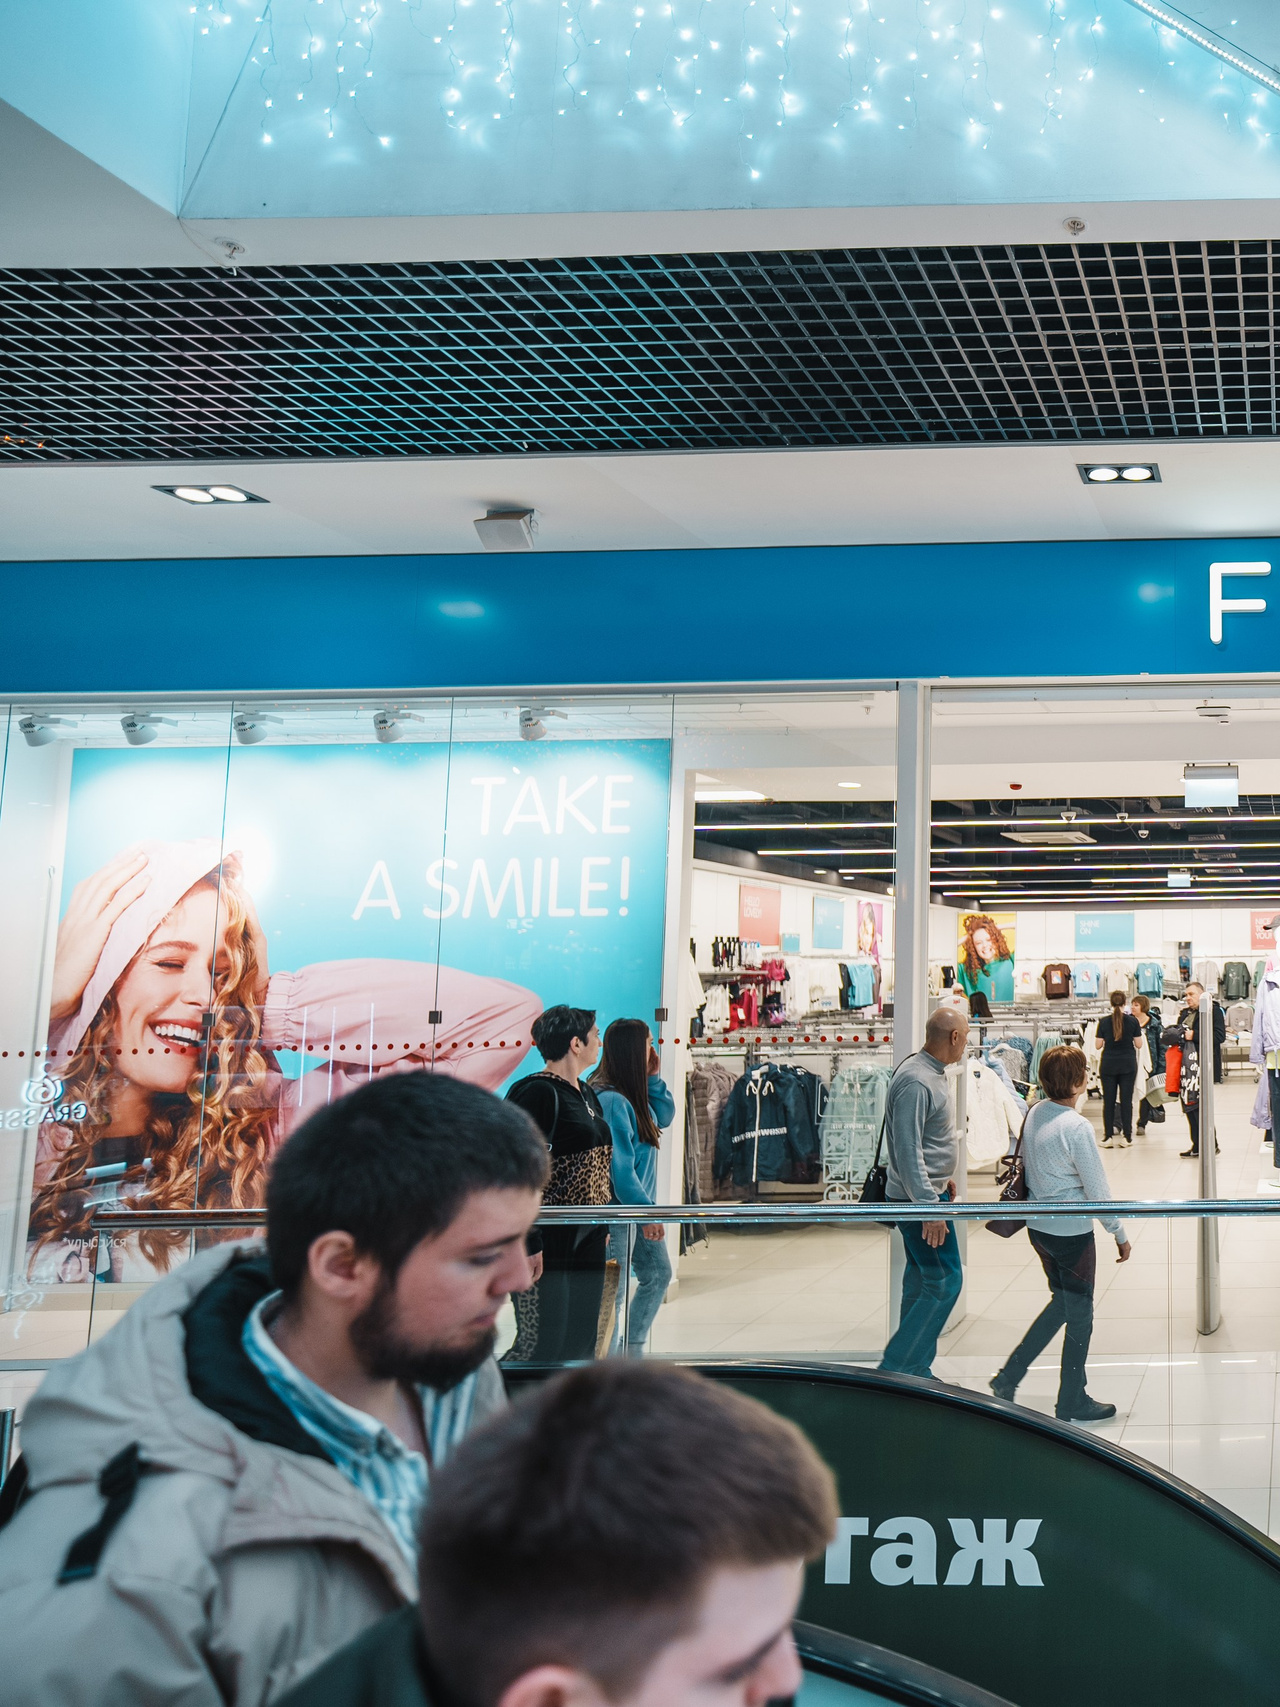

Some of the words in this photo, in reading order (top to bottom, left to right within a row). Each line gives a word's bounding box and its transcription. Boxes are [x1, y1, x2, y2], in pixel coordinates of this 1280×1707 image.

[471, 774, 634, 836] TAKE
[350, 859, 402, 921] A
[422, 856, 631, 920] SMILE!
[824, 1516, 1045, 1587] таж
